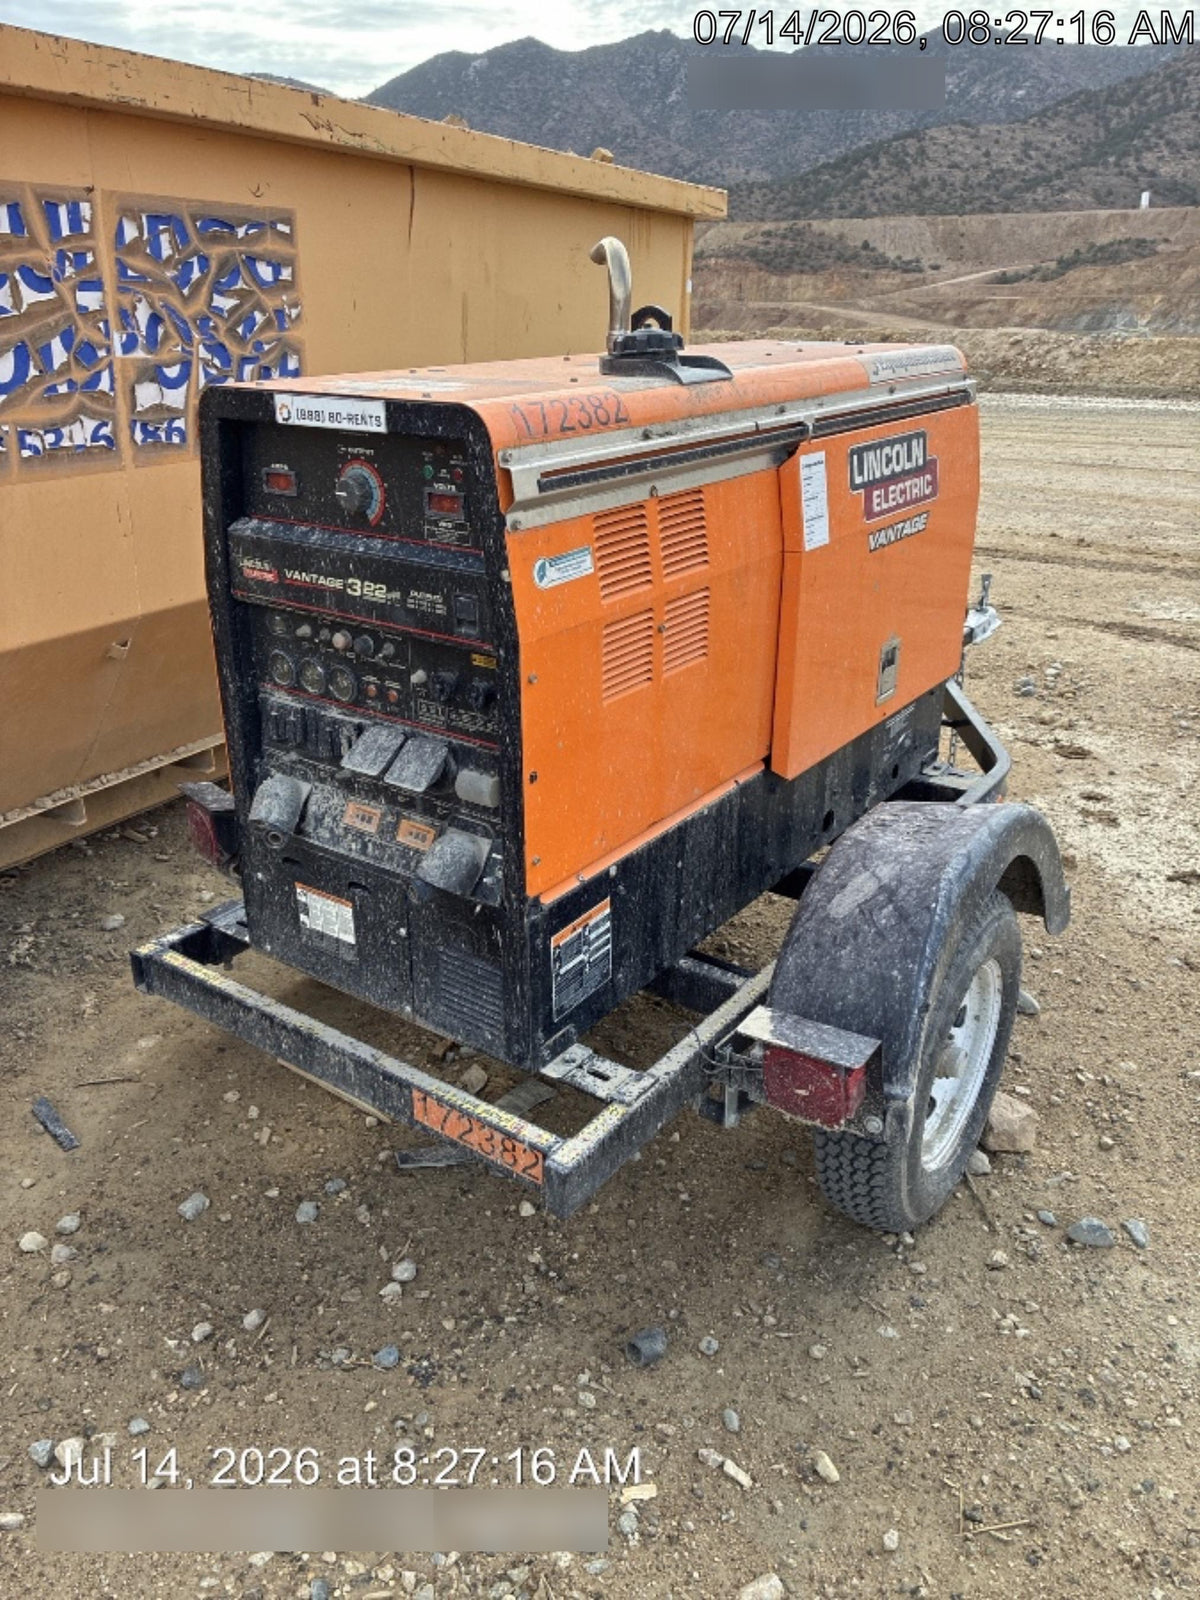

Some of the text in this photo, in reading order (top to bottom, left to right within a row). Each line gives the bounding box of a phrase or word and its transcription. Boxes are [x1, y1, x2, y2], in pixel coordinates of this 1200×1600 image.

[328, 411, 383, 428] 80-RENTS
[510, 391, 629, 437] 172382
[852, 436, 925, 485] LINCOLN
[872, 473, 933, 514] ELECTRIC
[868, 511, 930, 553] VANTAGE
[283, 567, 344, 590] VANTAGE
[416, 1093, 541, 1183] 172382
